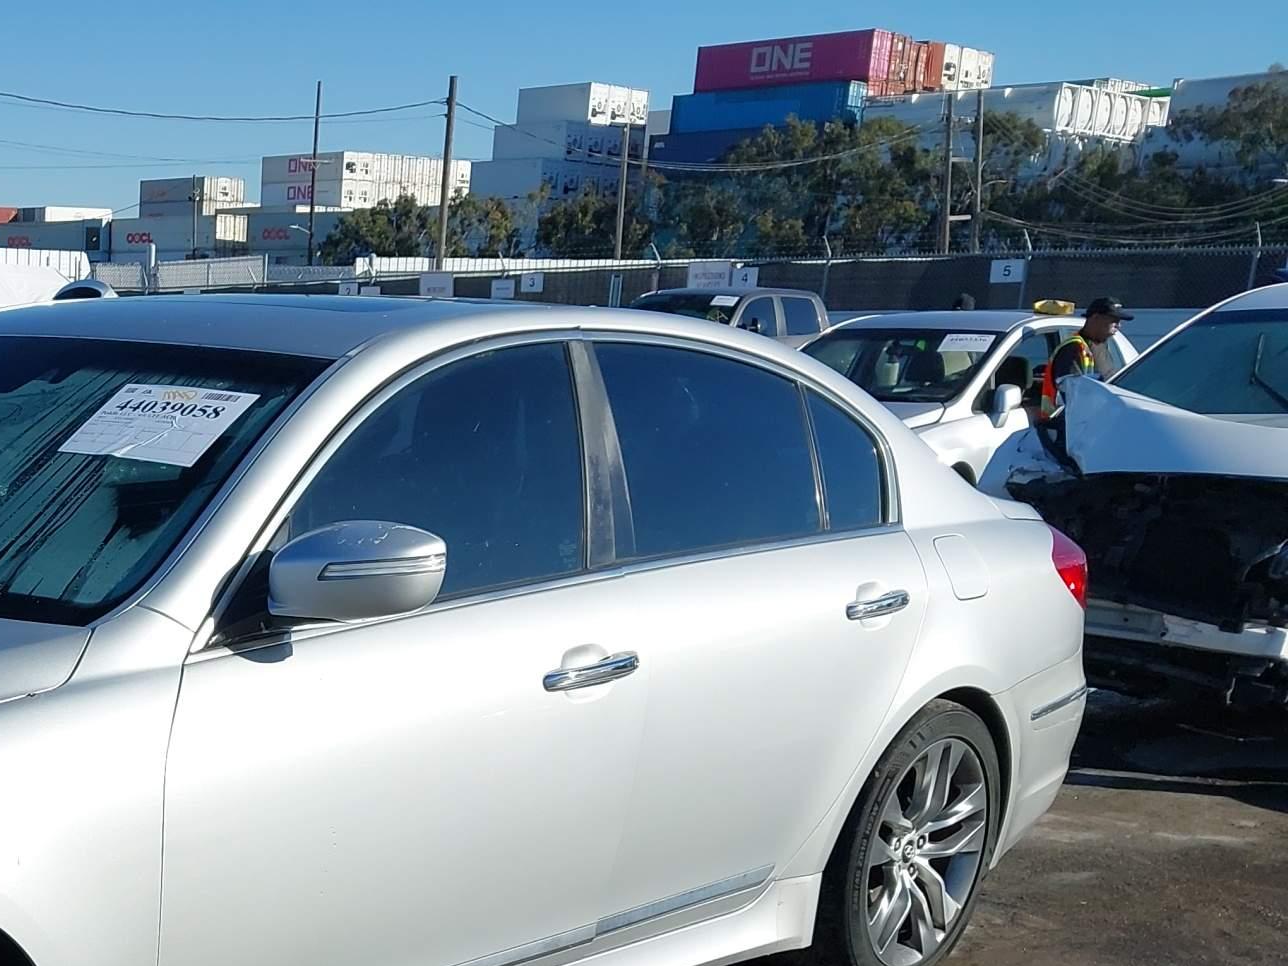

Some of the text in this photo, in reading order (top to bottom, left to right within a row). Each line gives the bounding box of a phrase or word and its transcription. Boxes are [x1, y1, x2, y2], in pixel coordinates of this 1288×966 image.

[751, 43, 813, 72] ONE
[1002, 265, 1012, 277] 5
[528, 277, 536, 288] 3
[116, 398, 226, 420] 44039058
